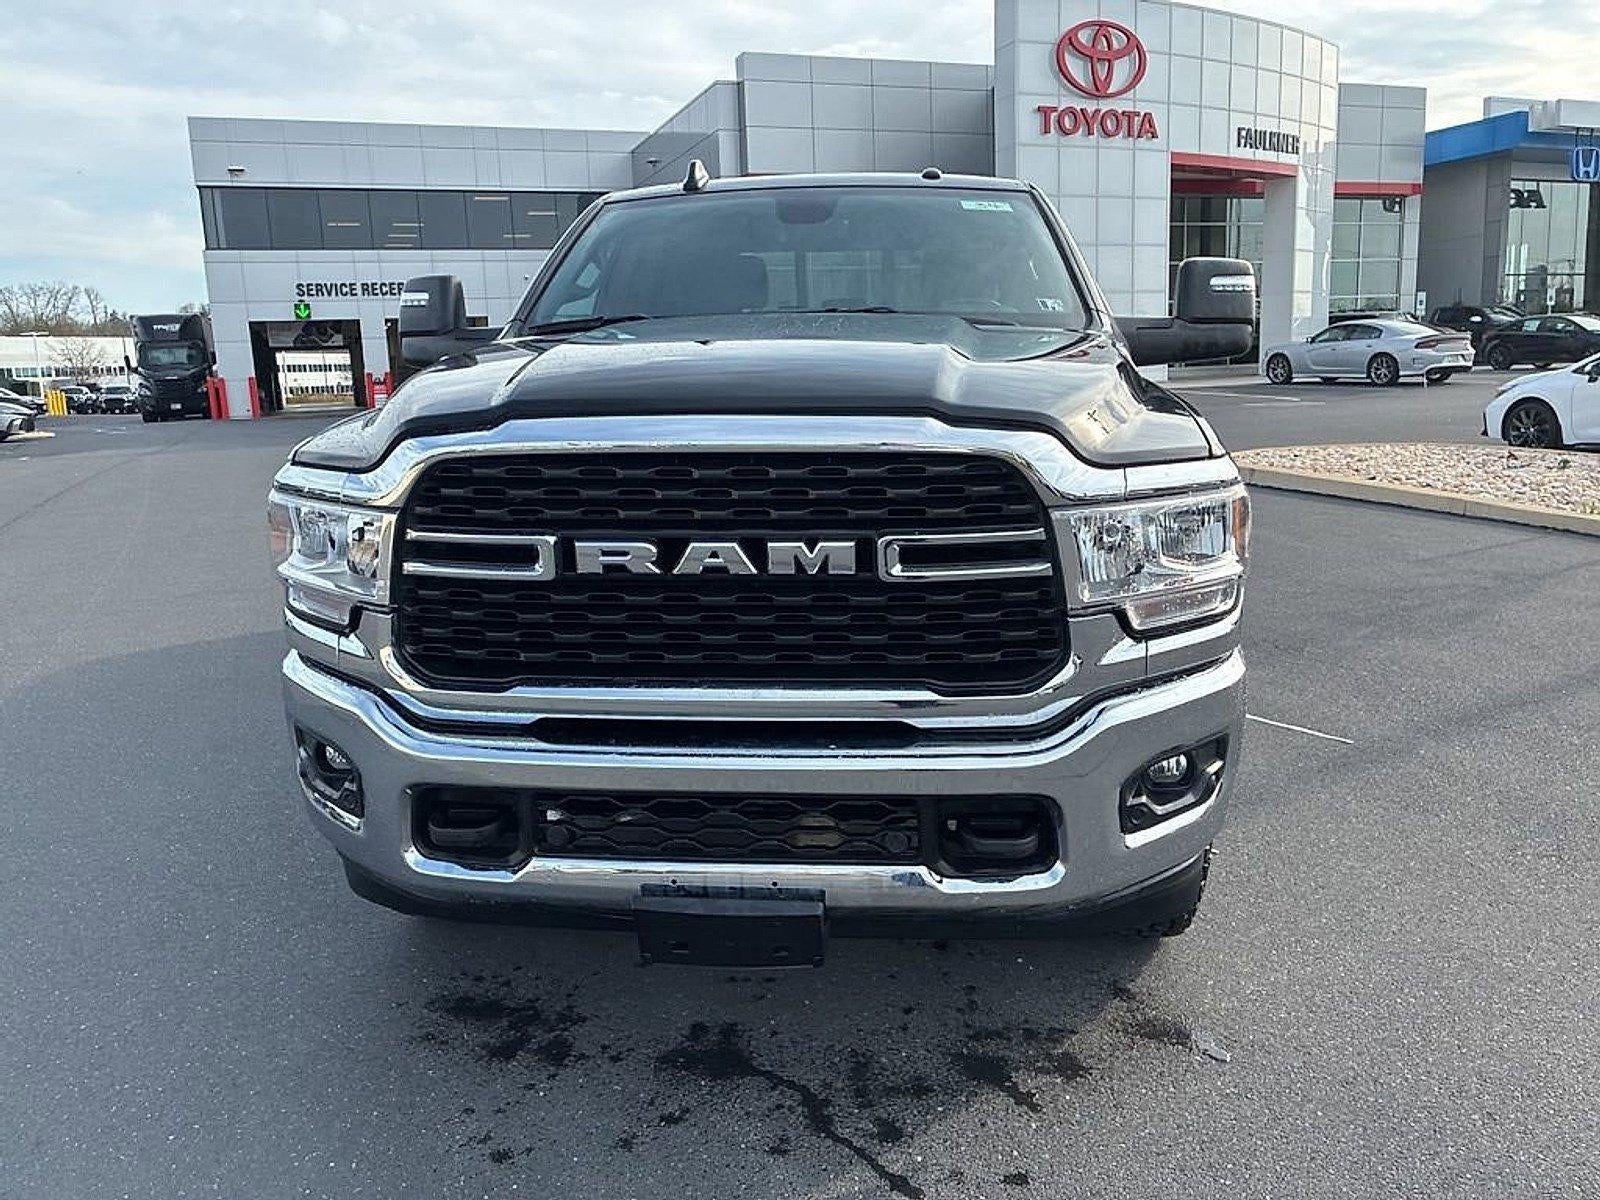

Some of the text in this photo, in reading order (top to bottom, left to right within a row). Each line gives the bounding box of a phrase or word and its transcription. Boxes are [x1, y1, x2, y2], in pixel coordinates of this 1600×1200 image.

[1037, 105, 1159, 139] TOYOTA
[1237, 126, 1300, 155] FAULKNER
[295, 282, 358, 297] SERVICE
[574, 541, 857, 575] RAM
